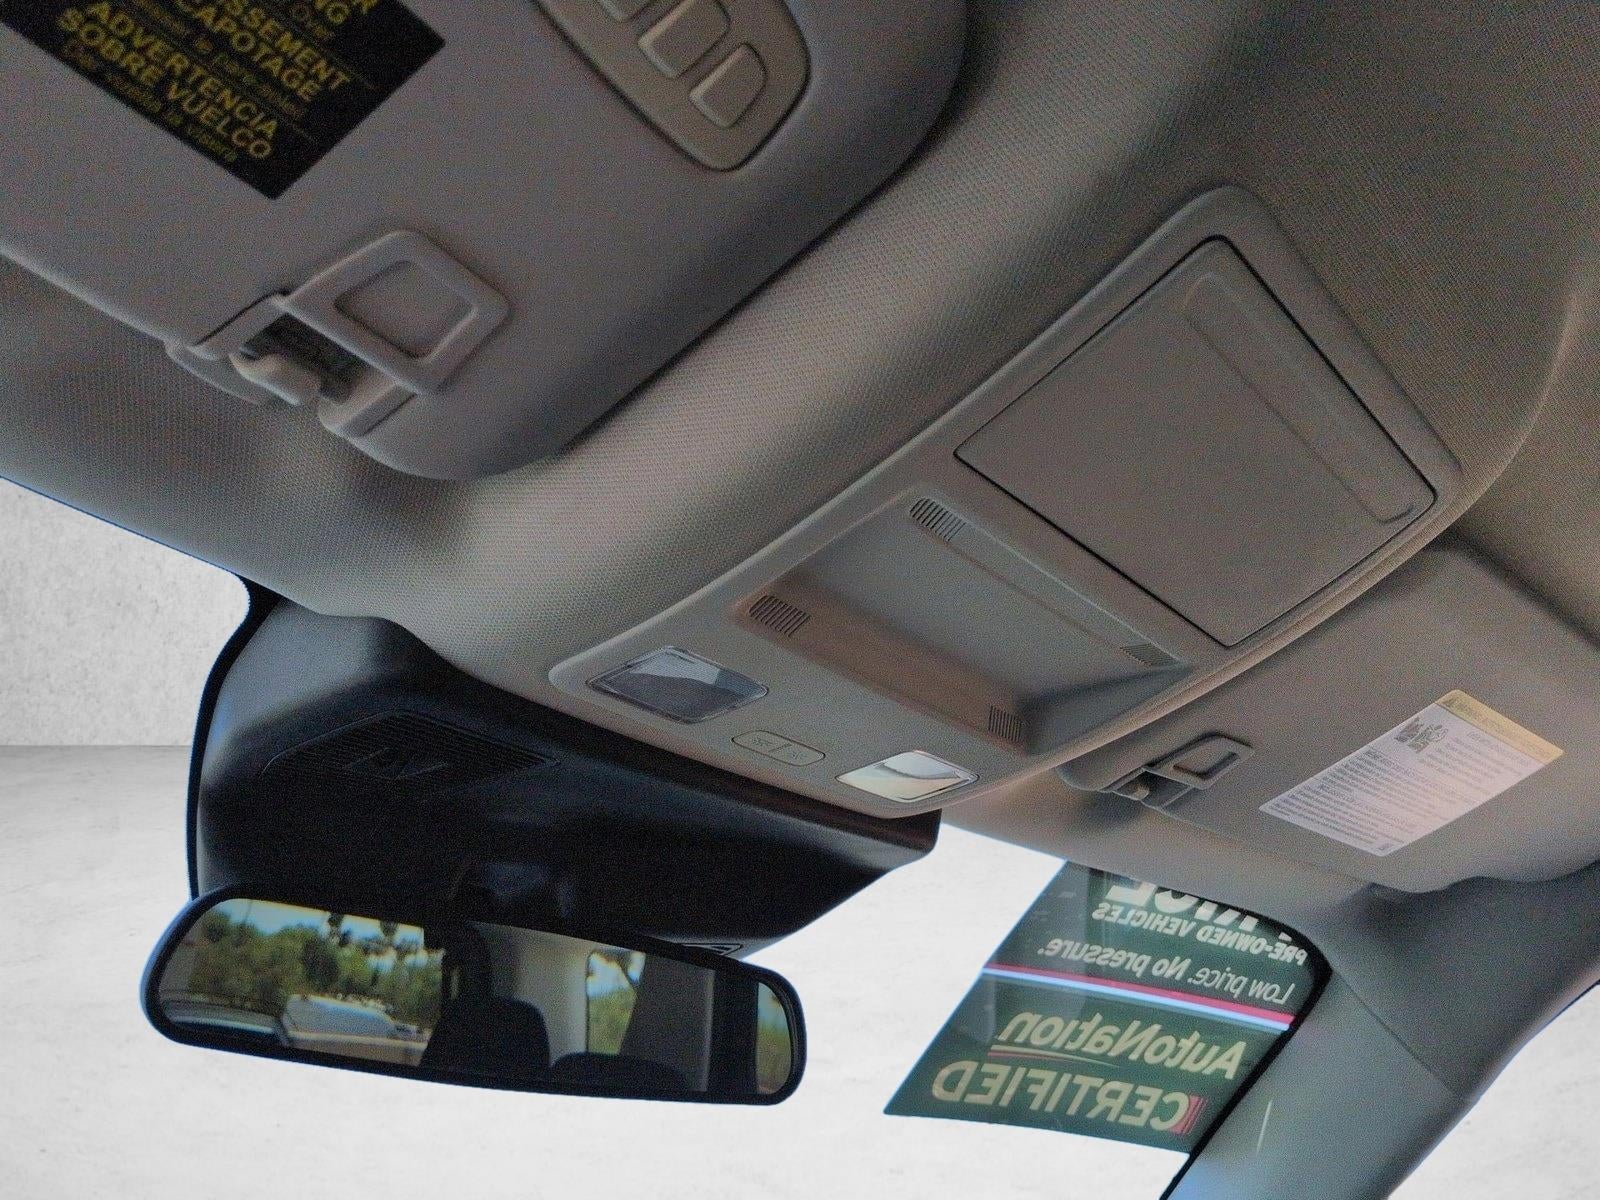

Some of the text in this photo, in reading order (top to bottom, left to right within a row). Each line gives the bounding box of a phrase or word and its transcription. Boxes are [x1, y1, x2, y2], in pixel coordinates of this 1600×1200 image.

[57, 7, 165, 89] SOBRE
[166, 80, 273, 160] VUELCO
[86, 1, 279, 140] ADVERTENCIA
